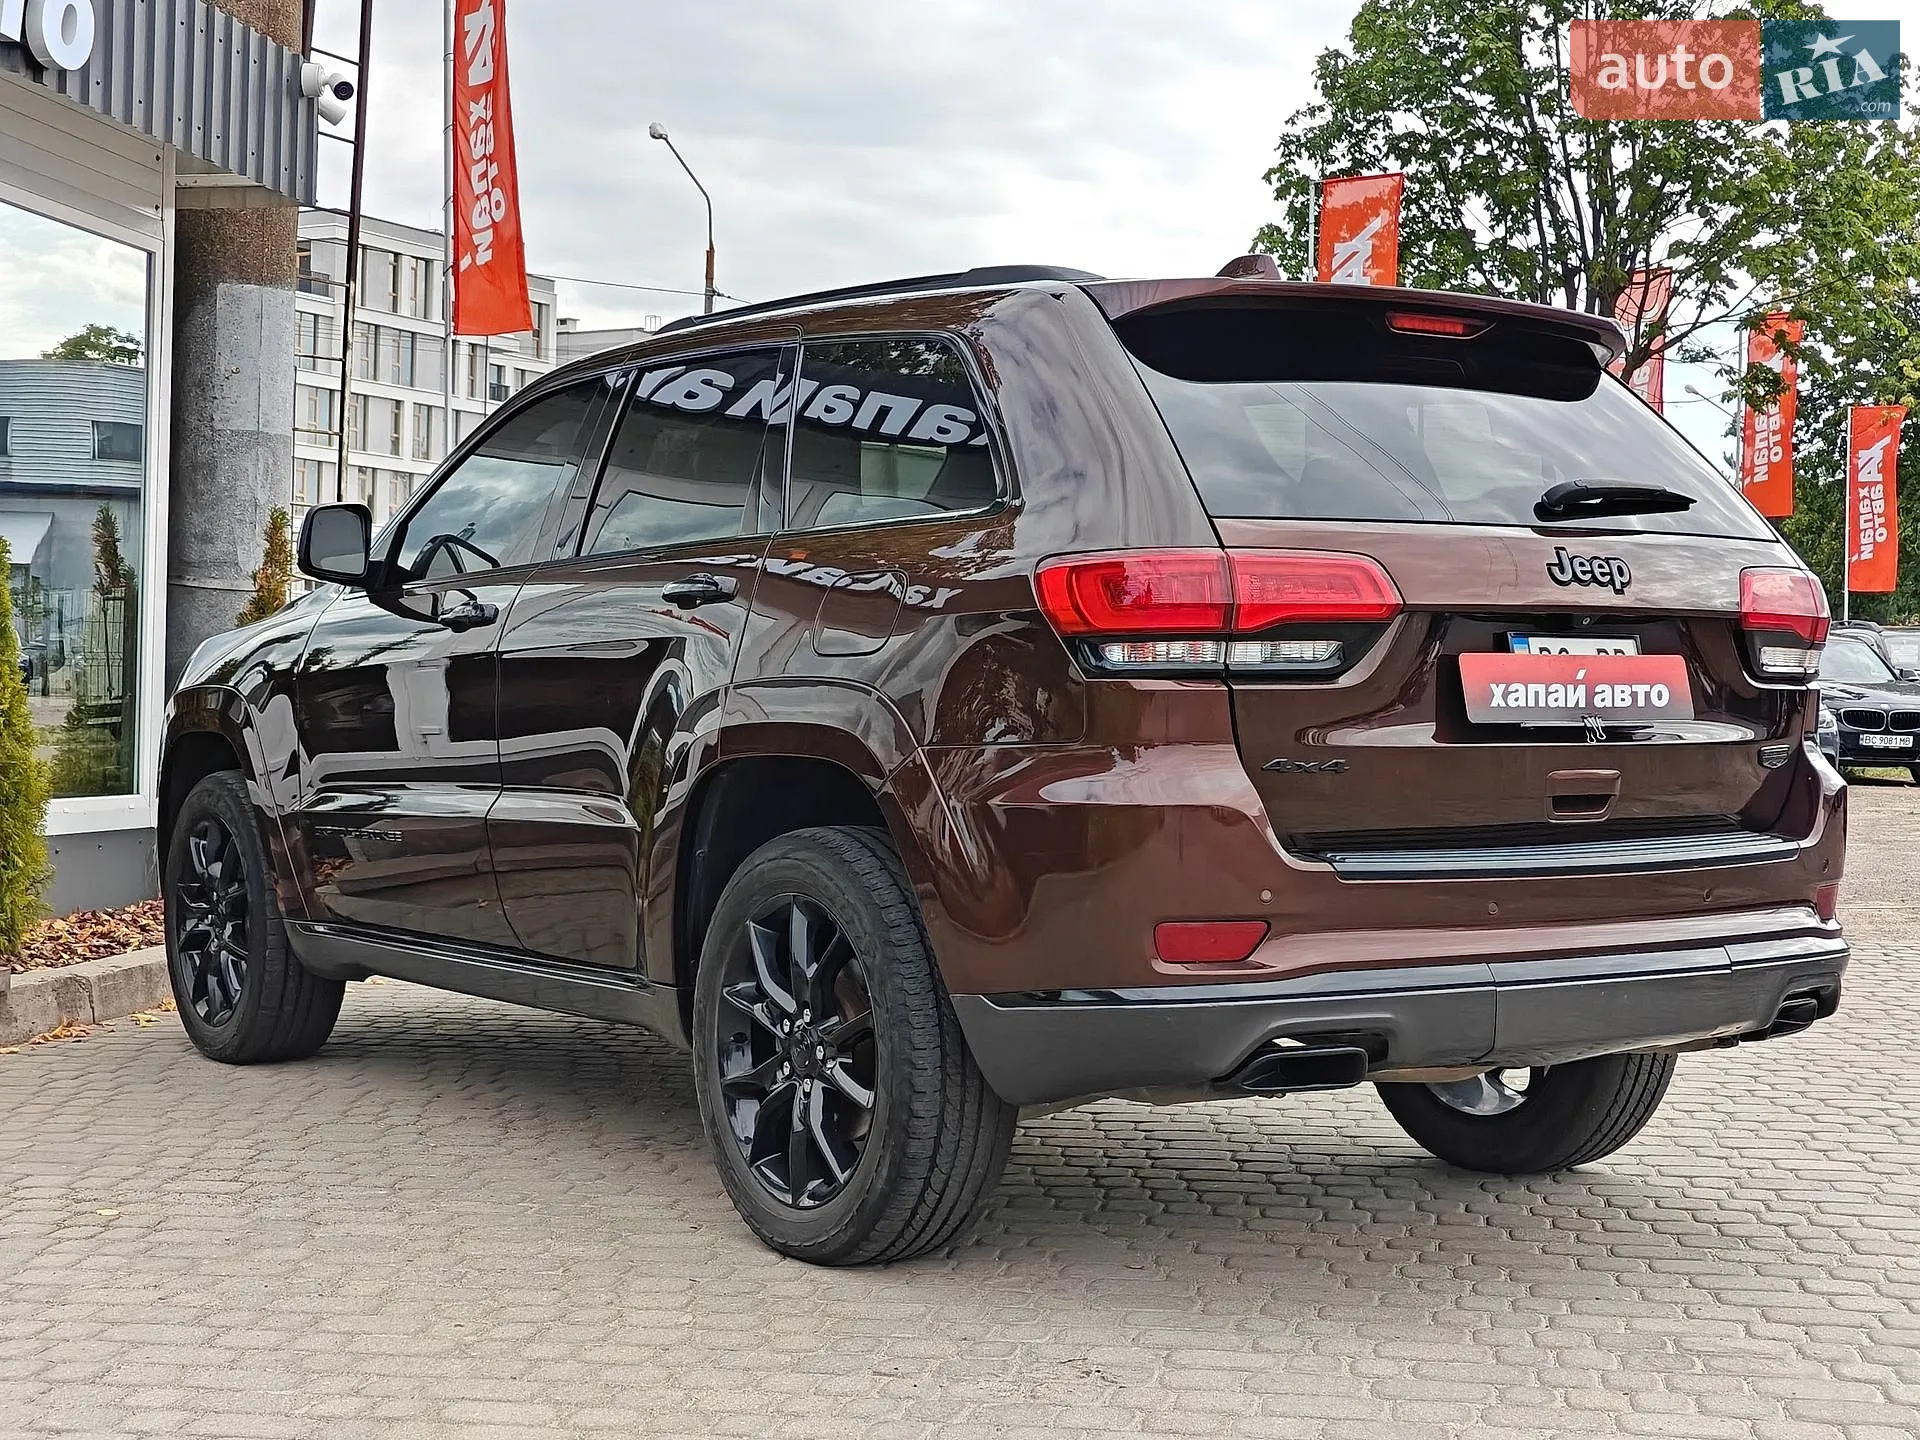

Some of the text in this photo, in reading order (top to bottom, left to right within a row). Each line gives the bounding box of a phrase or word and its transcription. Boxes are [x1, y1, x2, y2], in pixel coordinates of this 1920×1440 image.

[1545, 545, 1633, 596] Jeep
[1593, 682, 1671, 709] авто
[1864, 735, 1877, 745] BC
